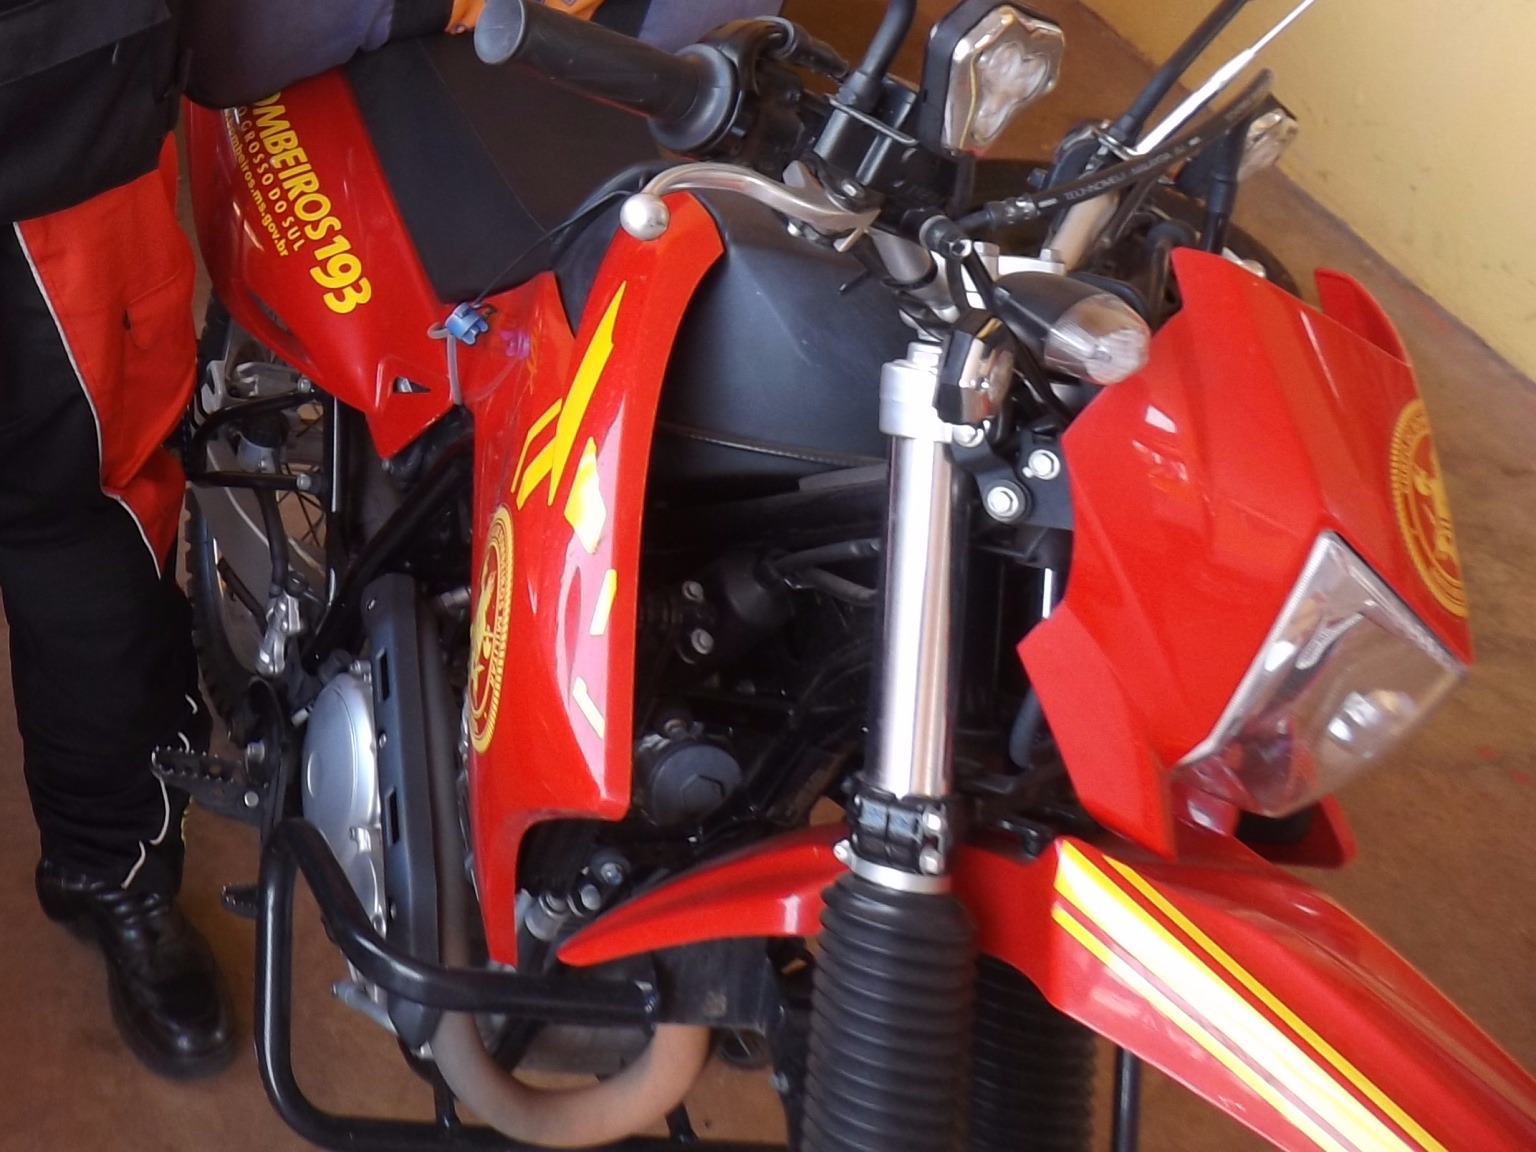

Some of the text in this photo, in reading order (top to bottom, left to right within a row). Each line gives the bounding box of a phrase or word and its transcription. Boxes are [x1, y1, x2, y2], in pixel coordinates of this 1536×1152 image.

[241, 120, 274, 186] GROSSO
[268, 187, 288, 214] DO
[281, 215, 306, 252] SUL
[253, 91, 372, 314] MBEIROS 193
